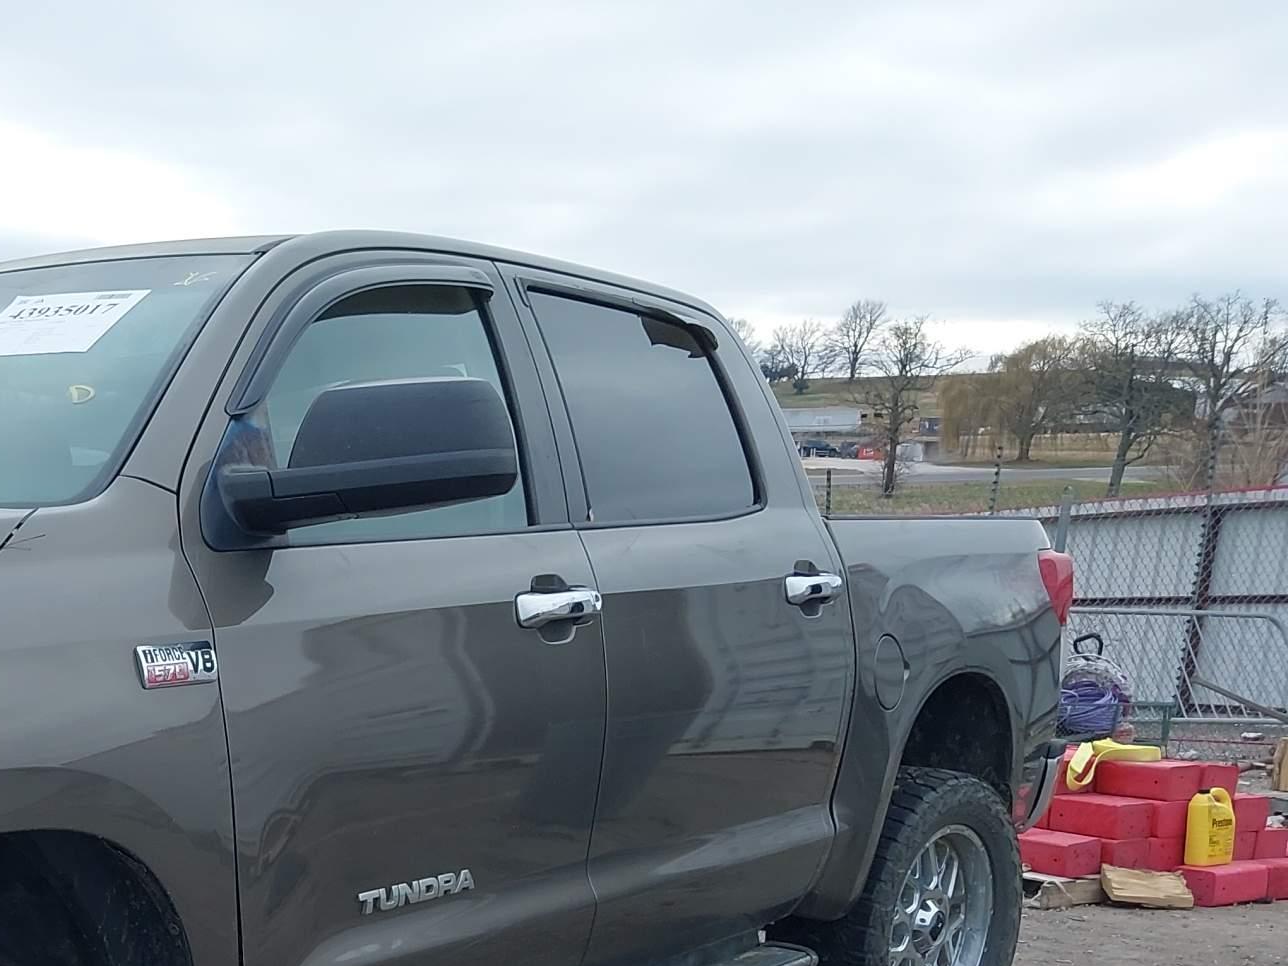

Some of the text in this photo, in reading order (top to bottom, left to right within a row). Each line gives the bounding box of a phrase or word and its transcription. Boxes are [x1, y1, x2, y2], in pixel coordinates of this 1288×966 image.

[8, 303, 120, 320] 43935017
[187, 650, 214, 673] V8
[358, 869, 475, 914] TUNDRA
